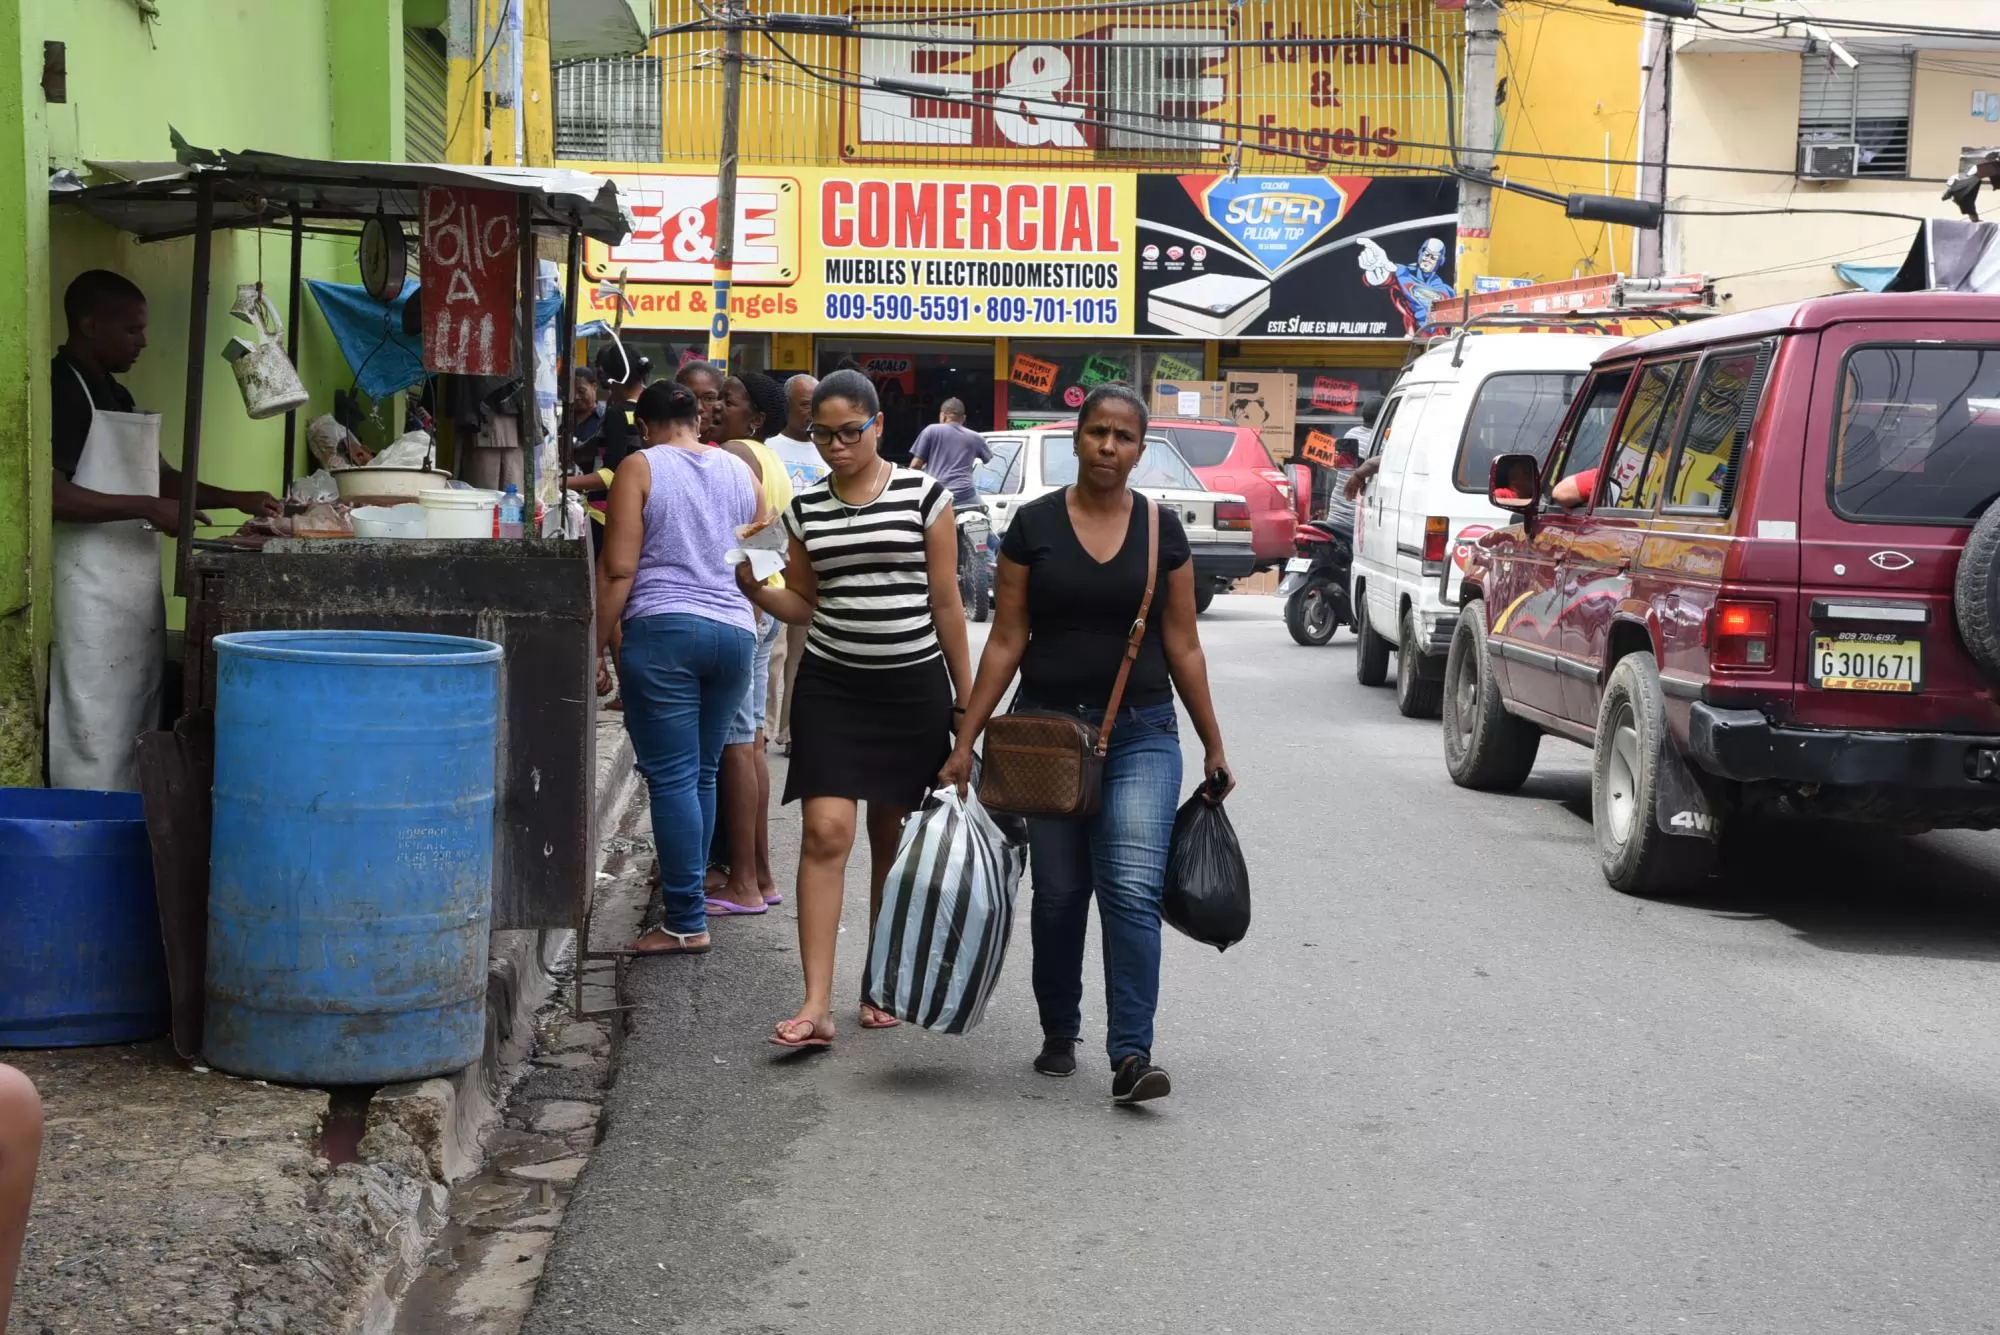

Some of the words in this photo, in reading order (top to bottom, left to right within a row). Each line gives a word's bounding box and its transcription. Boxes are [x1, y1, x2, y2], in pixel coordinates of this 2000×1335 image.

[1260, 21, 1410, 65] Edward
[1310, 70, 1342, 108] &
[1258, 114, 1399, 172] Engels
[821, 180, 1120, 252] COMERCIAL
[1225, 195, 1325, 225] SUPER
[423, 186, 511, 278] Pollo
[1243, 227, 1283, 241] PILLOW
[1284, 227, 1304, 241] TOP
[445, 267, 480, 306] A
[825, 258, 907, 286] MUEBLES
[910, 260, 923, 286] Y
[926, 261, 1119, 289] ELECTRODOMESTICOS
[688, 291, 708, 313] &
[730, 292, 798, 319] ngels
[825, 293, 969, 322] 809-590-5591
[986, 296, 1118, 324] 809-701-1015
[1267, 320, 1288, 333] ESTE
[1299, 321, 1316, 334] QUE
[1315, 321, 1327, 333] ES
[1326, 321, 1339, 334] UN
[1338, 321, 1368, 334] PILLOW
[1368, 321, 1388, 334] TOP!
[1838, 632, 1857, 640] 809
[1857, 633, 1897, 641] 701-6197
[1821, 651, 1914, 680] G301671
[1823, 678, 1847, 688] La
[1851, 679, 1911, 691] Goma
